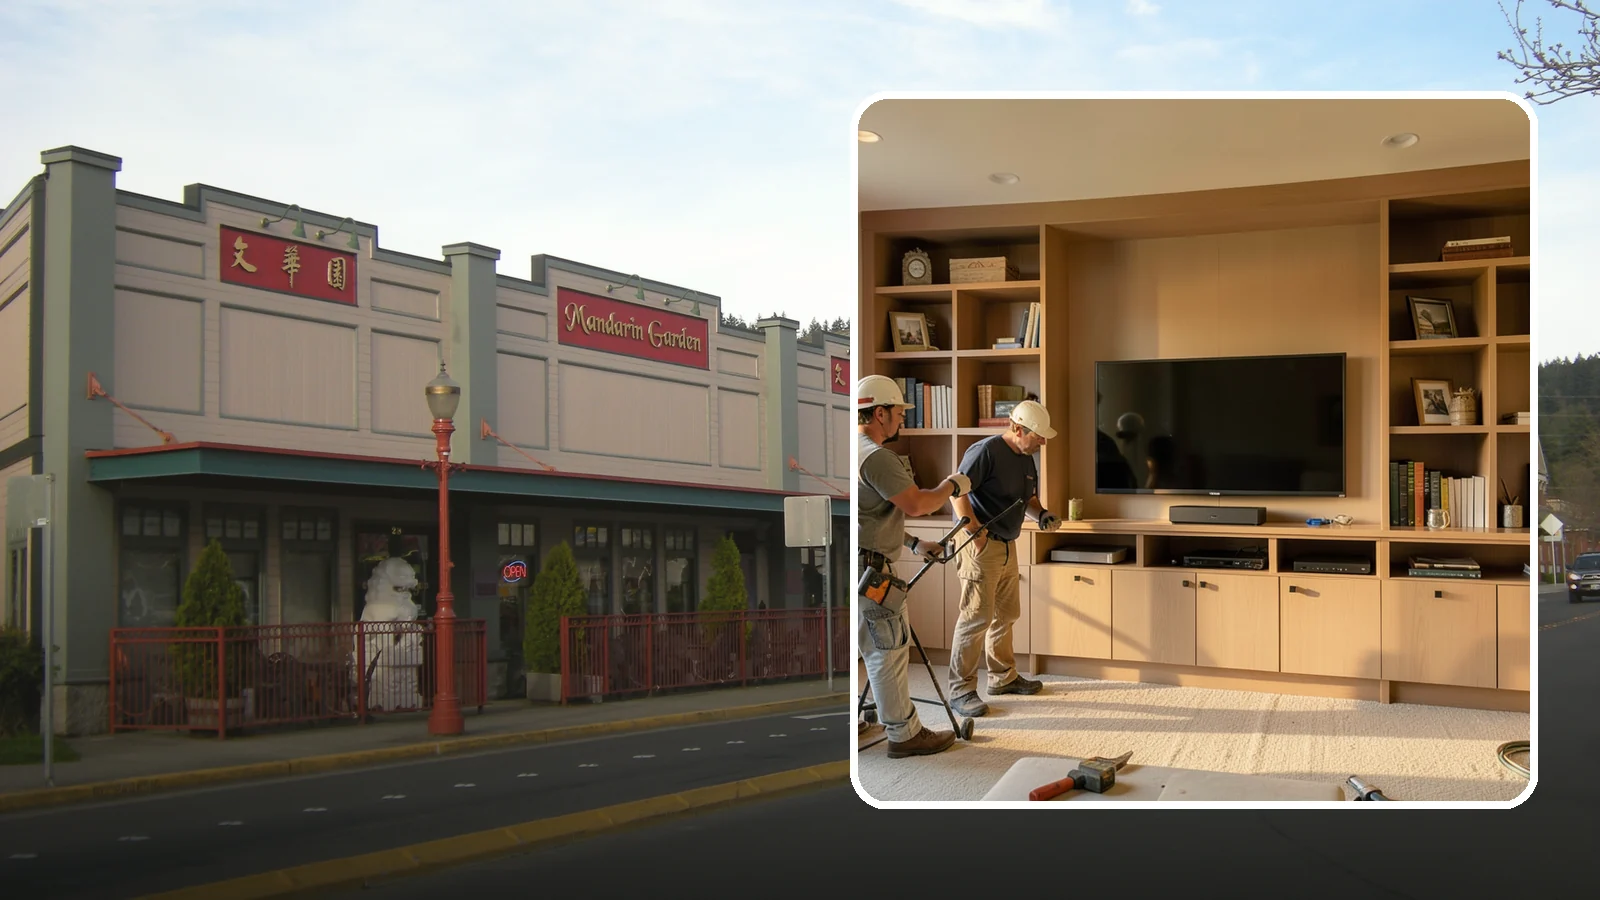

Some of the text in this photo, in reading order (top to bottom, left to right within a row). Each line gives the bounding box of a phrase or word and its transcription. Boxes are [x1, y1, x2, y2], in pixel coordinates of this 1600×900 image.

[231, 235, 346, 291] 文華園
[564, 302, 701, 352] Mandarin Garden
[503, 565, 527, 578] OPEN
